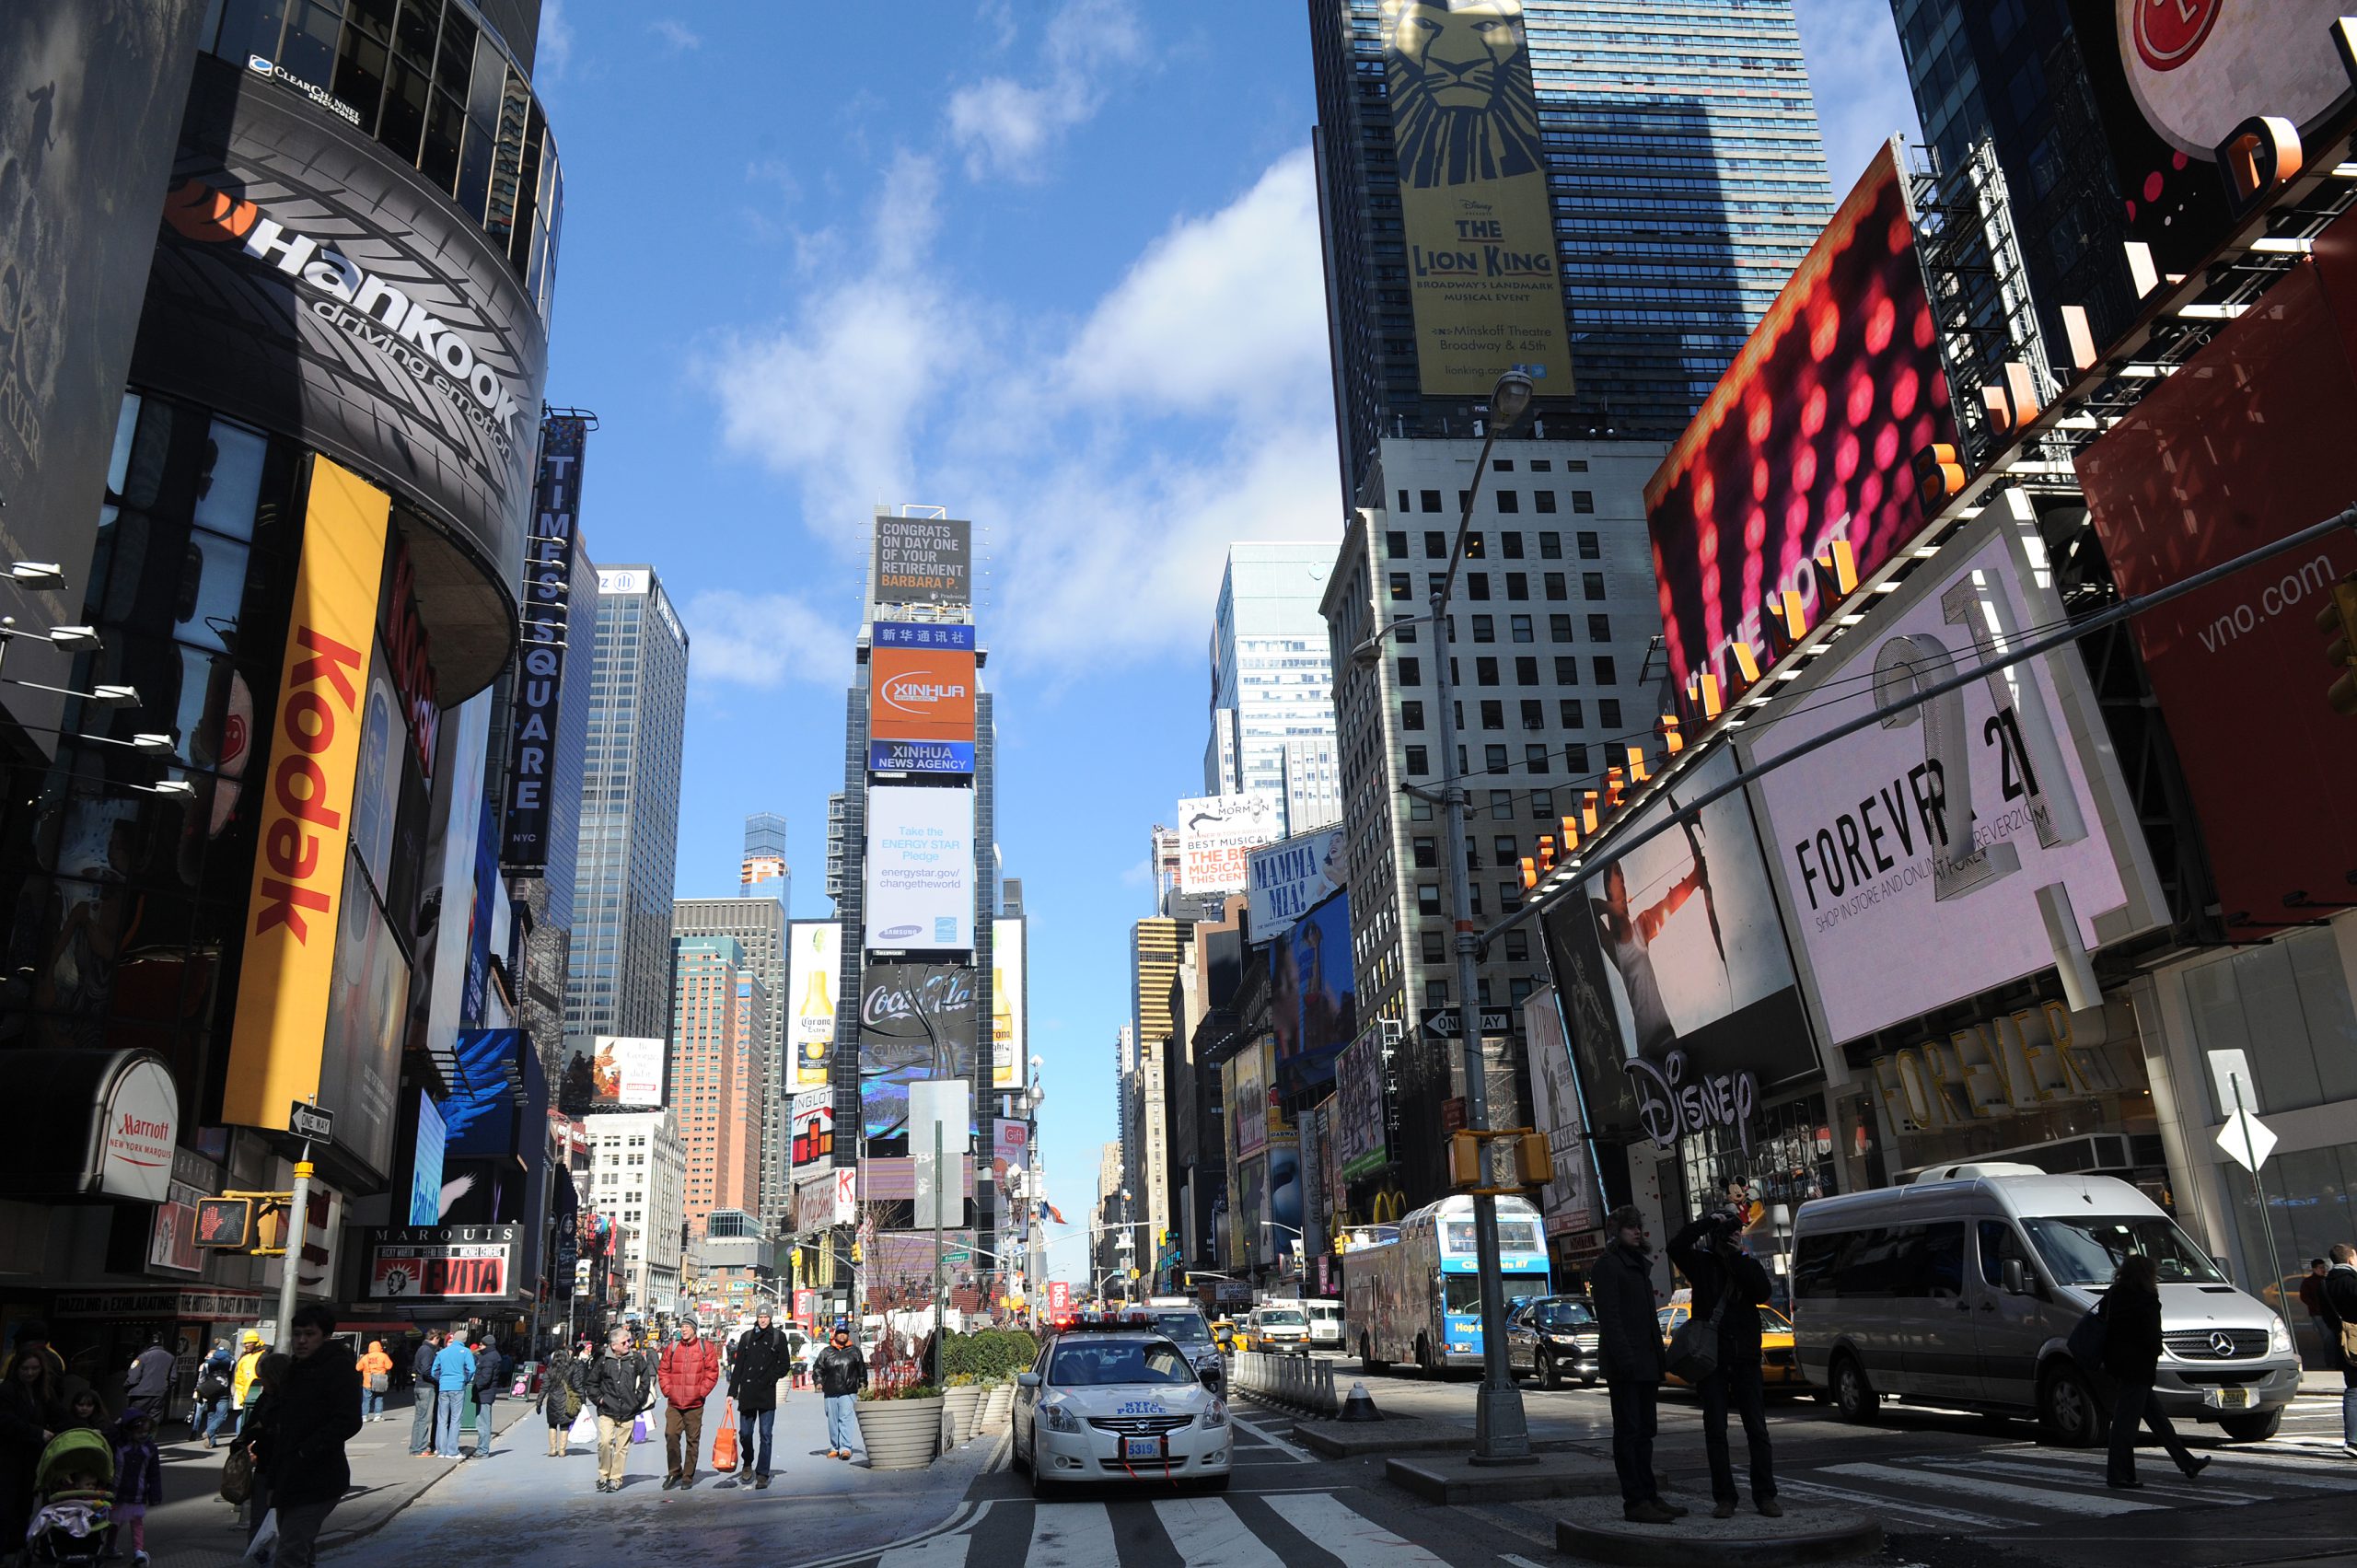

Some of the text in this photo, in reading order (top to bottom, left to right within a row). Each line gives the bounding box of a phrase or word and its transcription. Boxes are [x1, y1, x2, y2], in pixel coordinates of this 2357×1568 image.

[1459, 199, 1492, 212] Disney
[1455, 220, 1503, 238] THE
[1413, 245, 1551, 276] LION KING
[1490, 282, 1554, 290] LANDMARK
[1444, 294, 1531, 302] MUSICAL EVENT
[1454, 325, 1552, 337] Minskoff Theatre
[1440, 340, 1547, 353] Broadway & 45th
[1445, 365, 1508, 377] lionking.com
[313, 301, 512, 461] driving emotion
[883, 523, 951, 538] CONGRATS
[882, 537, 959, 551] ON DAY ONE
[882, 549, 937, 563] OF YOUR
[882, 562, 964, 577] RETIREMENT,
[882, 575, 958, 589] BARBARA P.
[2198, 555, 2335, 653] vno.com
[515, 457, 575, 810] TIMES SQUARE
[882, 629, 965, 644] 新华通讯社
[893, 683, 964, 698] XINHUA
[892, 746, 953, 759] XINHUA
[1984, 707, 2039, 802] 21
[878, 759, 967, 770] NEWS AGENCY
[256, 625, 361, 947] Kodak
[512, 833, 537, 843] NYC
[899, 827, 944, 836] Take the
[882, 840, 960, 849] ENERGY STAR
[1188, 835, 1271, 850] BEST MUSICAL
[902, 852, 940, 863] Pledge
[1189, 849, 1223, 864] THE
[881, 868, 960, 879] energystar.gov/
[1254, 846, 1317, 891] MAMMA
[879, 879, 961, 889] changetheworld
[1190, 874, 1215, 885] THIS
[1269, 880, 1306, 920] MIA!
[1817, 907, 1840, 933] SHOP
[1840, 903, 1852, 920] IN
[1851, 886, 1880, 916] STORE
[1882, 874, 1903, 900] AND
[1903, 857, 1936, 889] ONLIN
[802, 1017, 831, 1028] Corona
[1438, 1016, 1461, 1029] ON
[737, 1001, 749, 1091] NOVOTEL
[1871, 999, 2092, 1135] FOREVER
[795, 1091, 832, 1109] INGLOT
[118, 1113, 168, 1141] Marriott
[302, 1114, 329, 1132] ONE WAY
[1006, 1129, 1023, 1142] Gift
[110, 1138, 173, 1158] NEW YORK MARQUIS
[376, 1228, 513, 1242] MARQUIS
[381, 1248, 396, 1257] RICKY
[397, 1248, 415, 1257] MARTIN
[1515, 1260, 1528, 1269] NY
[425, 1260, 498, 1294] EVITA
[1054, 1283, 1066, 1307] tkts
[58, 1296, 102, 1313] DAZZLING
[103, 1300, 109, 1312] &
[110, 1295, 176, 1313] EXHILARATING!
[181, 1295, 192, 1312] THE
[192, 1295, 216, 1313] HOTTEST
[217, 1296, 235, 1314] TICKET
[236, 1297, 242, 1314] IN
[798, 1291, 810, 1316] tkts
[1456, 1322, 1475, 1333] Hop
[178, 1357, 195, 1365] OFFICE
[1128, 1444, 1153, 1456] 5319
